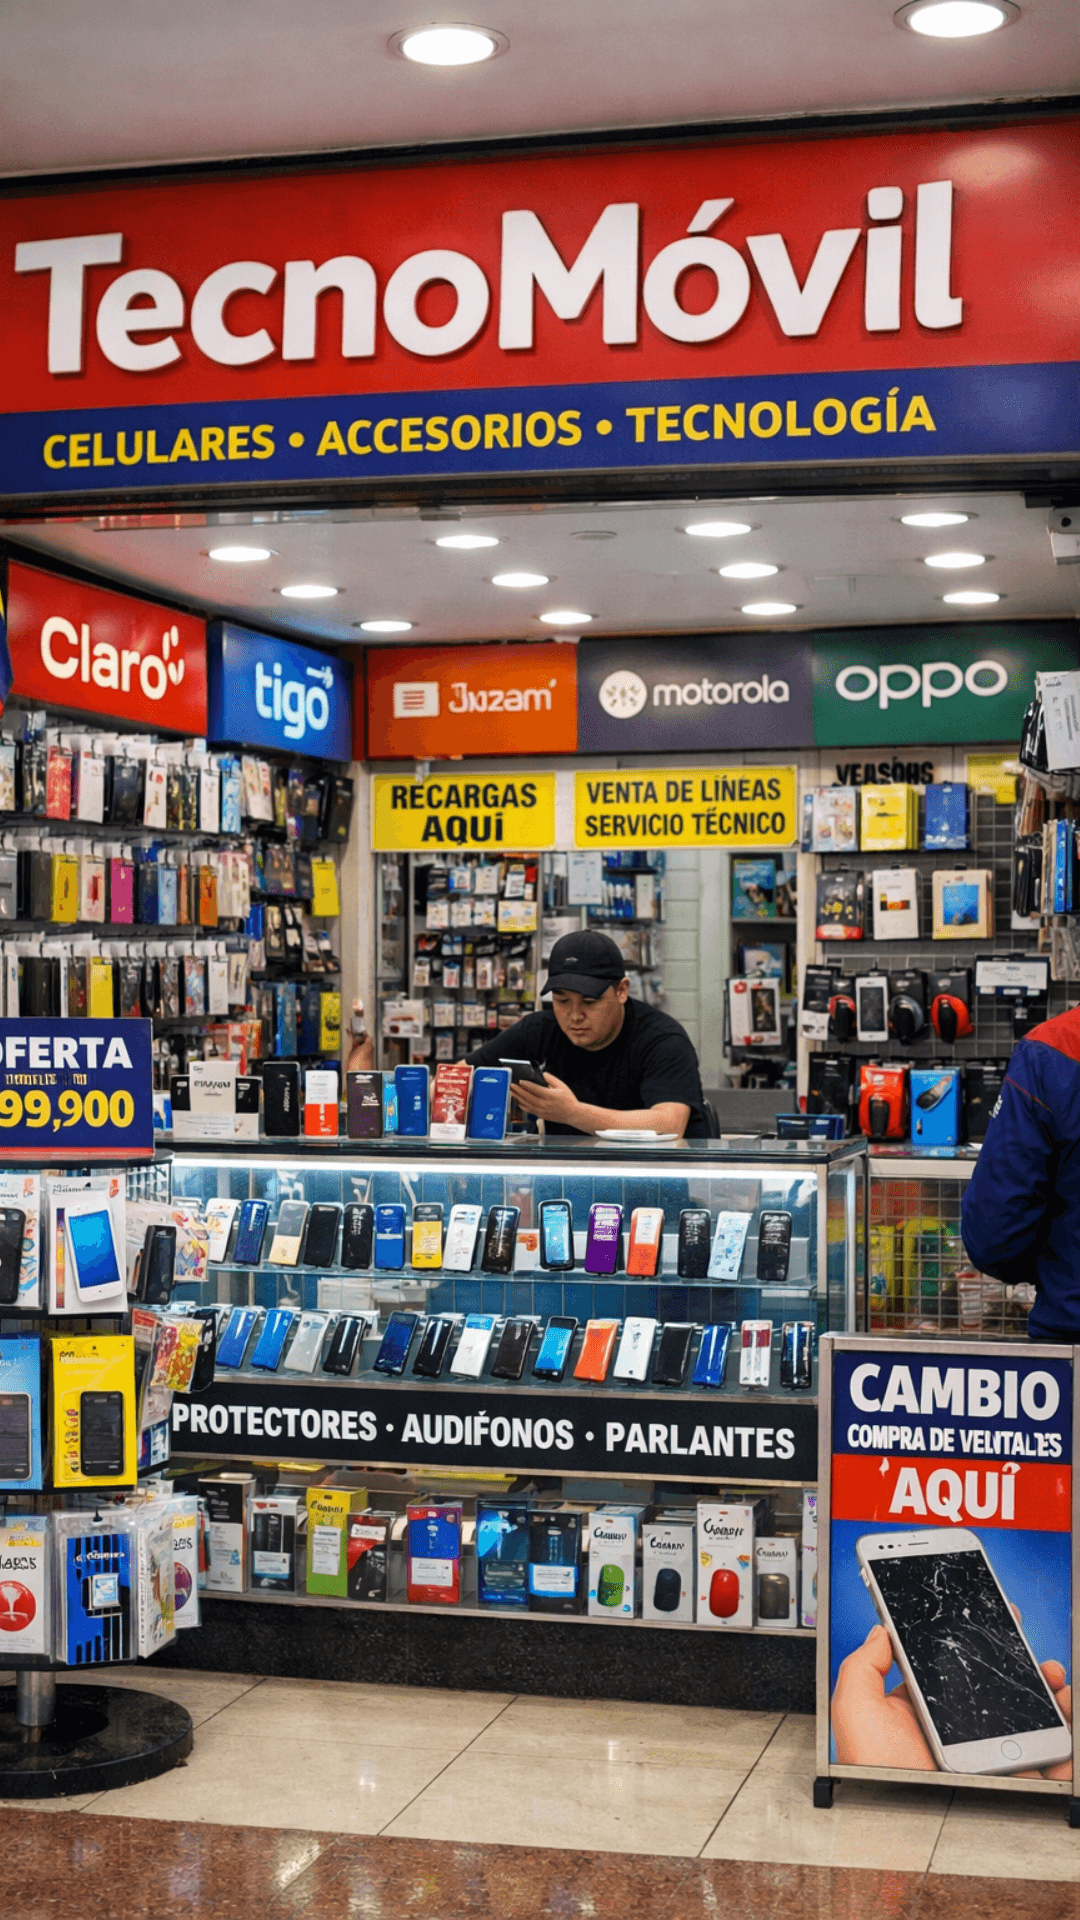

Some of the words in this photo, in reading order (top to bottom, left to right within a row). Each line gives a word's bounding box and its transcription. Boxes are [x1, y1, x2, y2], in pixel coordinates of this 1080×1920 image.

[14, 181, 965, 375] TecnoMóvil
[43, 423, 275, 470] CELULARES
[316, 410, 582, 457] ACCESORIOS
[626, 386, 937, 443] TECNOLOGÍA
[41, 616, 167, 700] Claro
[256, 662, 330, 739] tigo
[652, 674, 790, 707] motorola
[835, 659, 1009, 711] oppo
[391, 783, 538, 809] RECARGAS
[586, 781, 659, 804] VENTA
[666, 779, 693, 803] DE
[421, 812, 503, 845] AQUÍ
[585, 813, 685, 837] SERVICIO
[691, 806, 786, 835] TÉCNICO
[0, 1036, 134, 1069] FERTA
[850, 1363, 1061, 1421] CAMBIO
[172, 1402, 378, 1442] PROTECTORES
[606, 1421, 796, 1460] PARLANTES
[847, 1423, 927, 1451] COMPRA
[929, 1427, 955, 1452] DE
[888, 1461, 1022, 1523] AQUÍ
